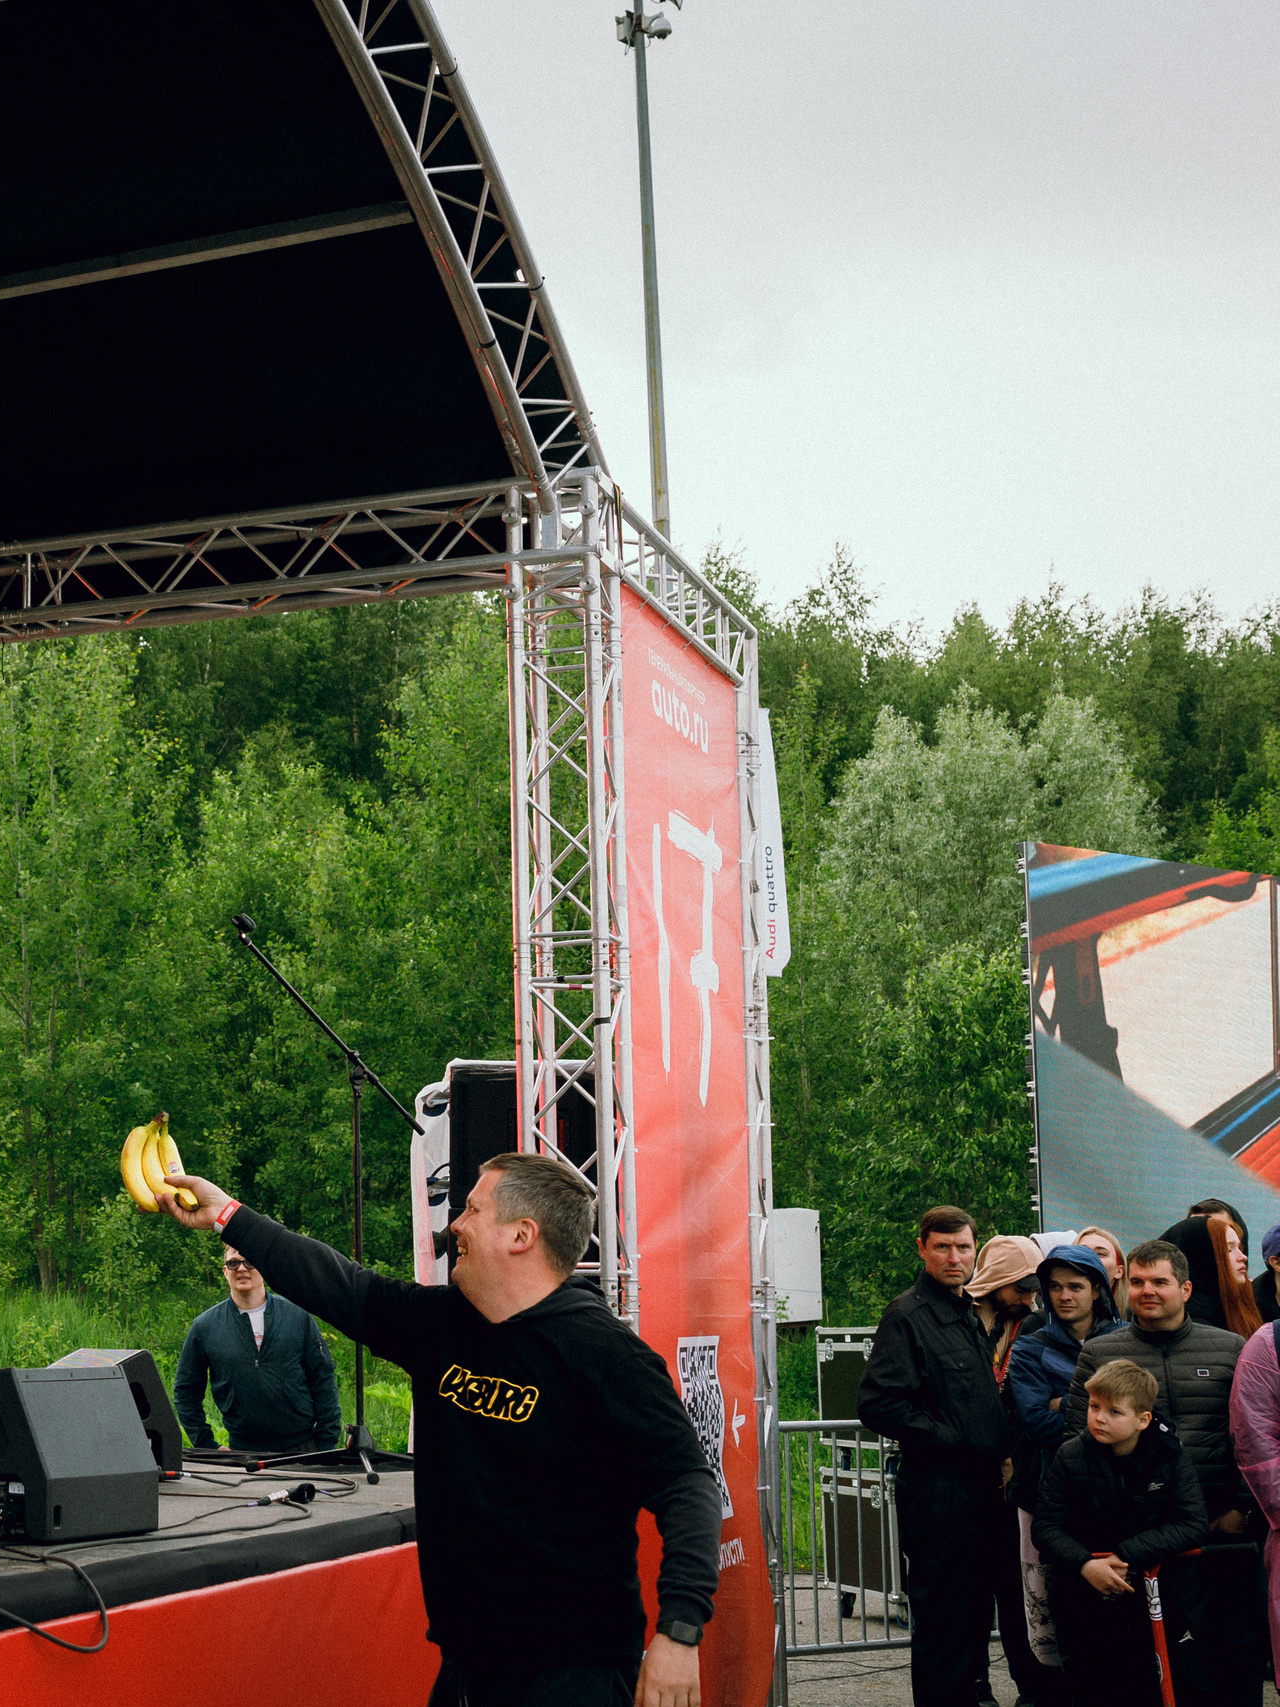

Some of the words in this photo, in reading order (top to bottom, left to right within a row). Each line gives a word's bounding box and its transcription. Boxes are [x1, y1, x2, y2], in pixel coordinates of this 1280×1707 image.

[651, 679, 709, 755] auto.ru
[764, 846, 778, 913] quattro
[765, 919, 777, 959] Audi
